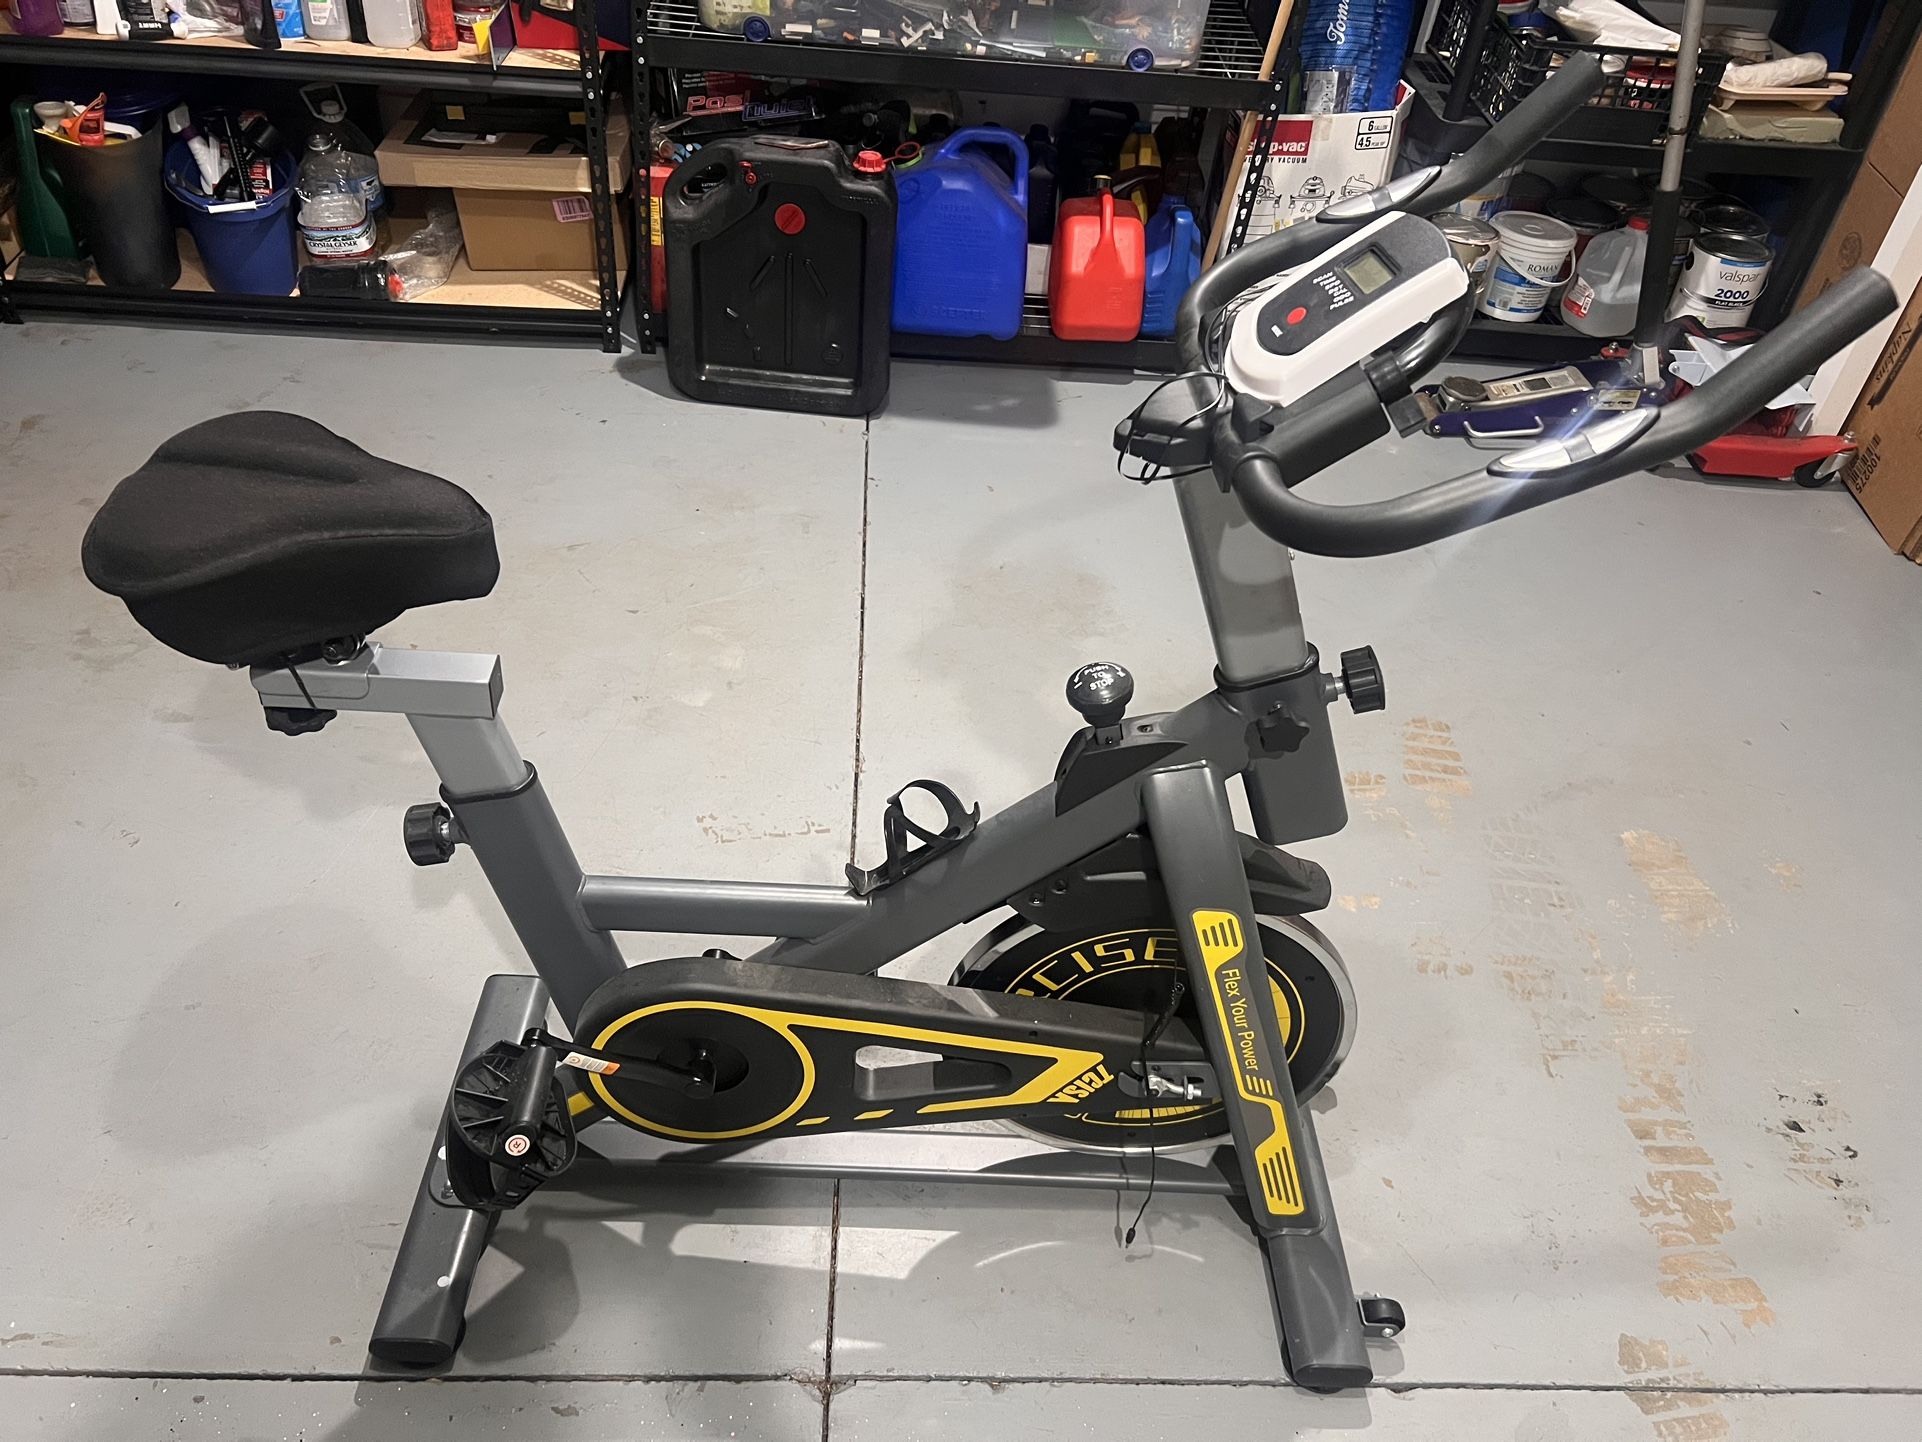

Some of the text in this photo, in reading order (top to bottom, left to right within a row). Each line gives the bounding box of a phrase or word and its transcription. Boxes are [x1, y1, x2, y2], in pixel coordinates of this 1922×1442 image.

[1327, 0, 1349, 44] Tom
[1368, 120, 1375, 131] 6
[1358, 136, 1372, 148] 4.5
[1278, 156, 1308, 164] VACUUM
[308, 240, 358, 249] CRYSTAL GEYSER
[1527, 263, 1558, 273] ROMAN
[1313, 272, 1333, 284] SCAN
[1319, 276, 1337, 287] TIME
[1719, 270, 1761, 285] valspar
[1333, 288, 1348, 297] CAL
[1714, 288, 1750, 300] 2000
[1329, 296, 1354, 310] PULSE
[1875, 322, 1913, 383] Napkins
[1855, 452, 1881, 494] 100275
[1084, 665, 1109, 675] PUSH
[1092, 671, 1106, 679] TO
[1089, 677, 1114, 691] STOP
[1015, 937, 1178, 998] CISE
[1221, 967, 1259, 1071] Flex Your Power
[1046, 1064, 1115, 1103] TCISA
